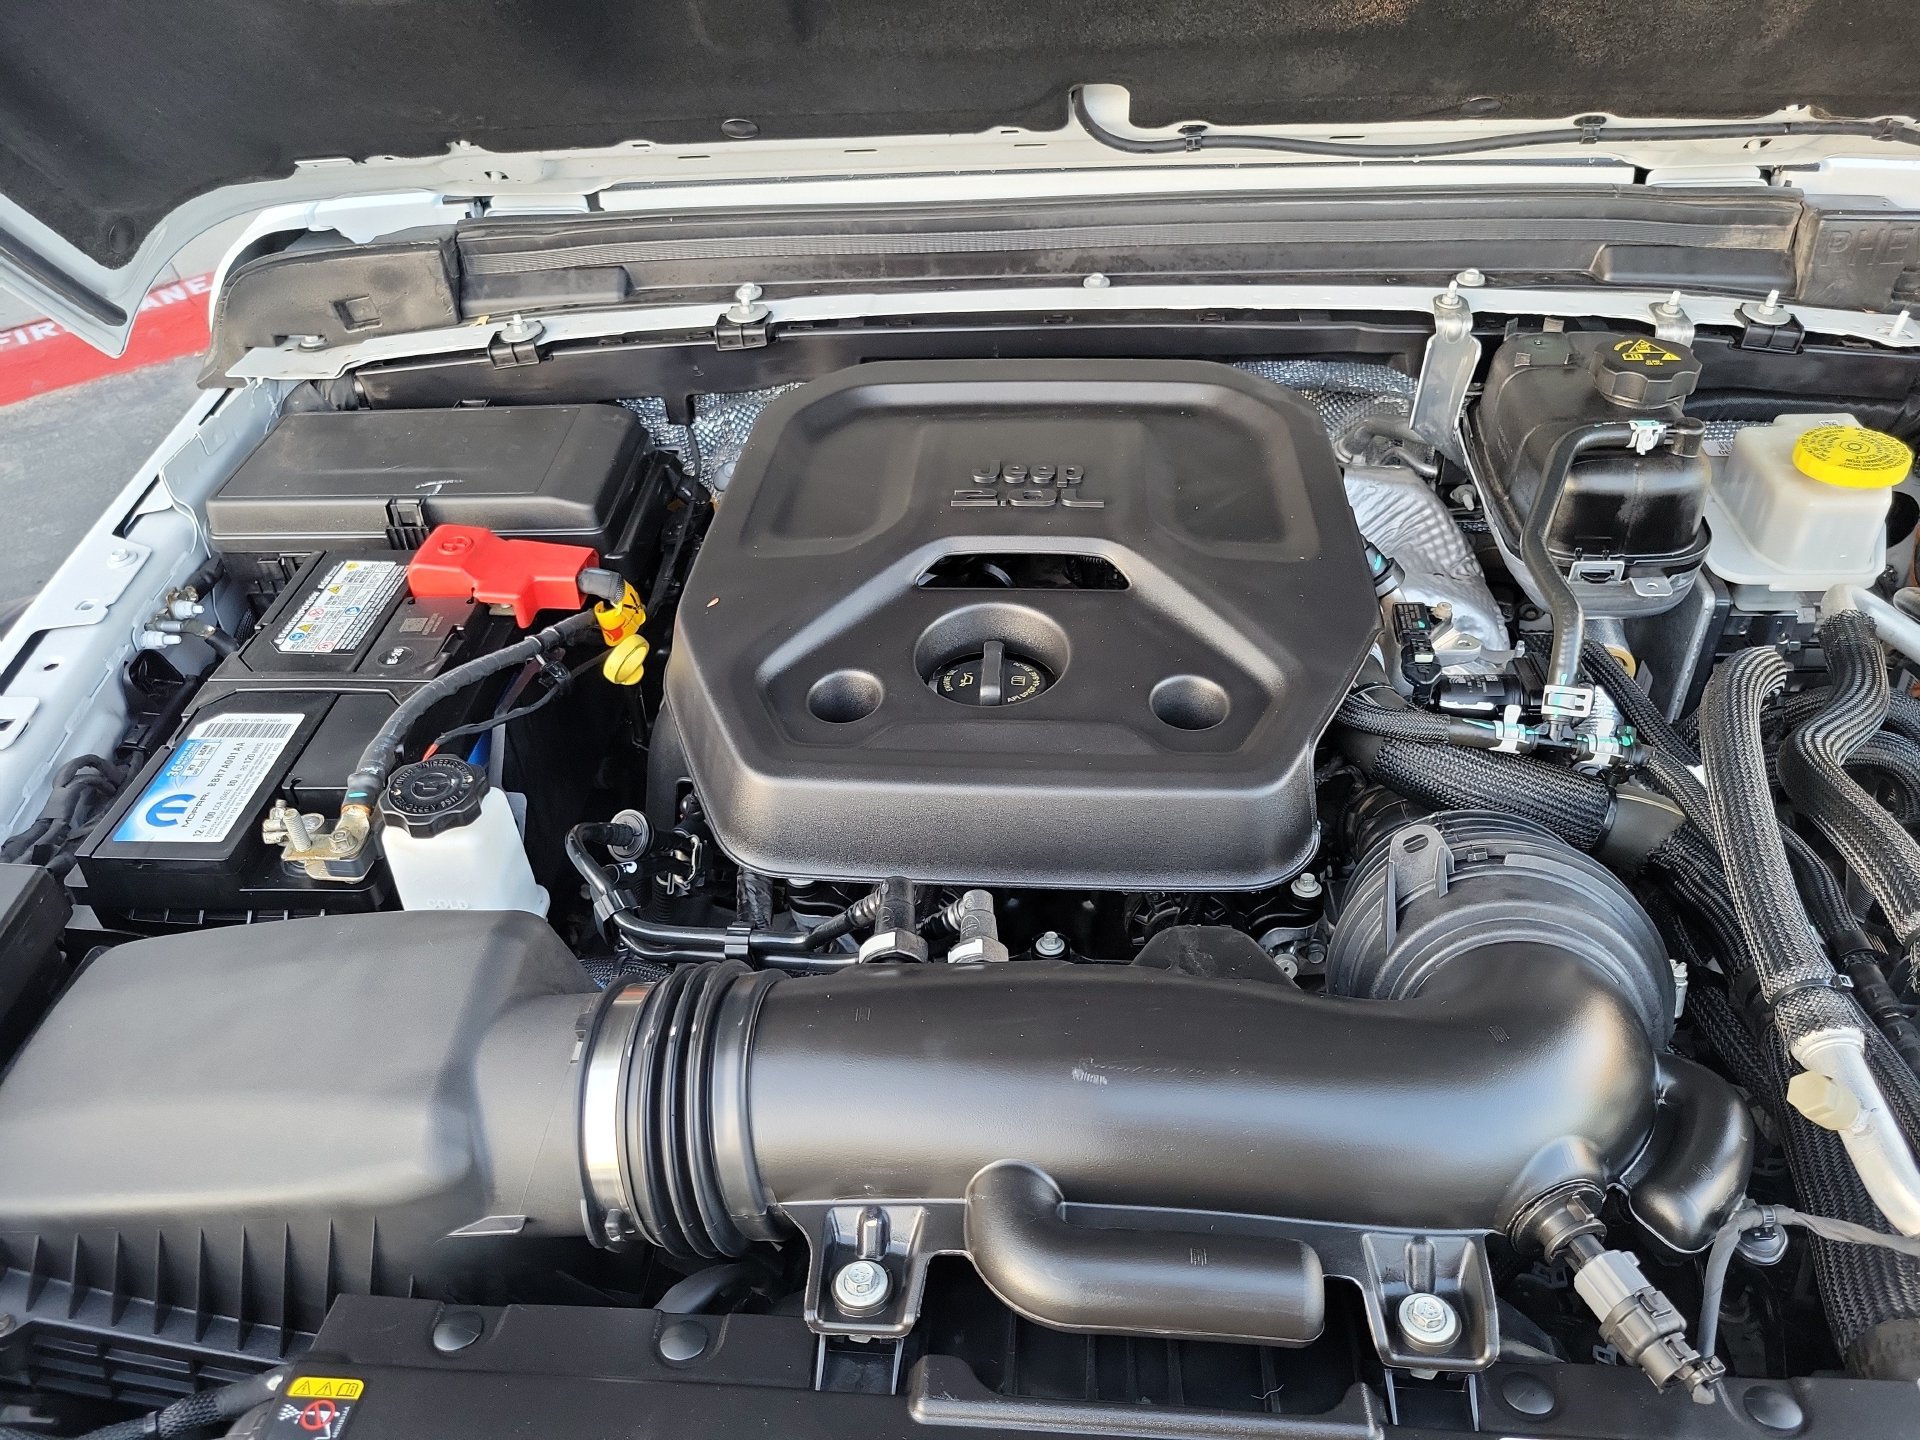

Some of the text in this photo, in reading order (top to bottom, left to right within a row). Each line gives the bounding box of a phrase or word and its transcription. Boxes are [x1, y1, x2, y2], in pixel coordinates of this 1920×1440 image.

[0, 276, 211, 345] FIR ANE
[972, 459, 1085, 488] Jeep
[951, 488, 1105, 508] 2.0L
[165, 765, 184, 776] 36
[201, 811, 217, 822] 700
[241, 753, 256, 763] 120
